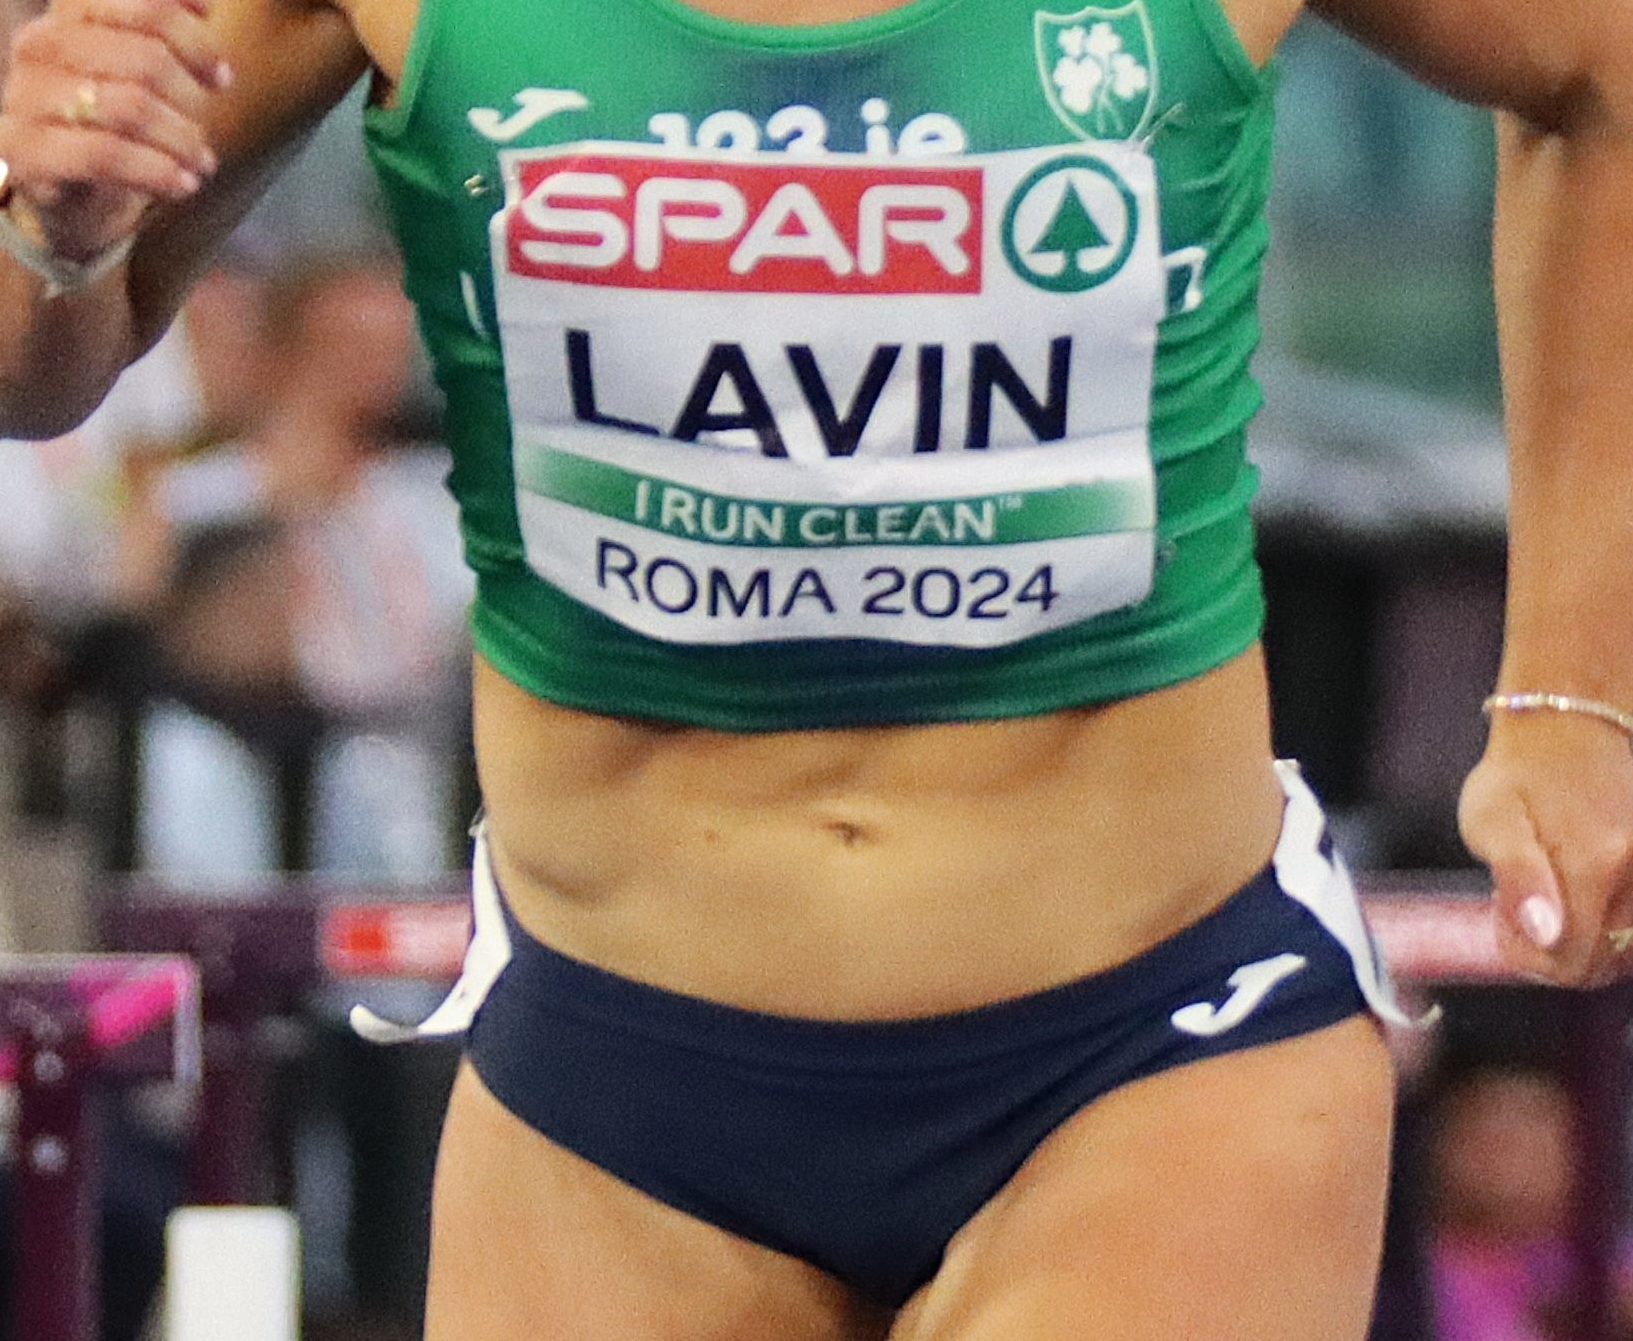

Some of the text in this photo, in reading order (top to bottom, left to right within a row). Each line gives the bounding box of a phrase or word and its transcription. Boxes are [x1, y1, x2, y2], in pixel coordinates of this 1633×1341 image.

[520, 173, 971, 275] SPAR
[567, 329, 1074, 458] LAVIN
[635, 481, 651, 521] I
[662, 488, 783, 541] RUN
[596, 539, 1060, 619] ROMA 2024
